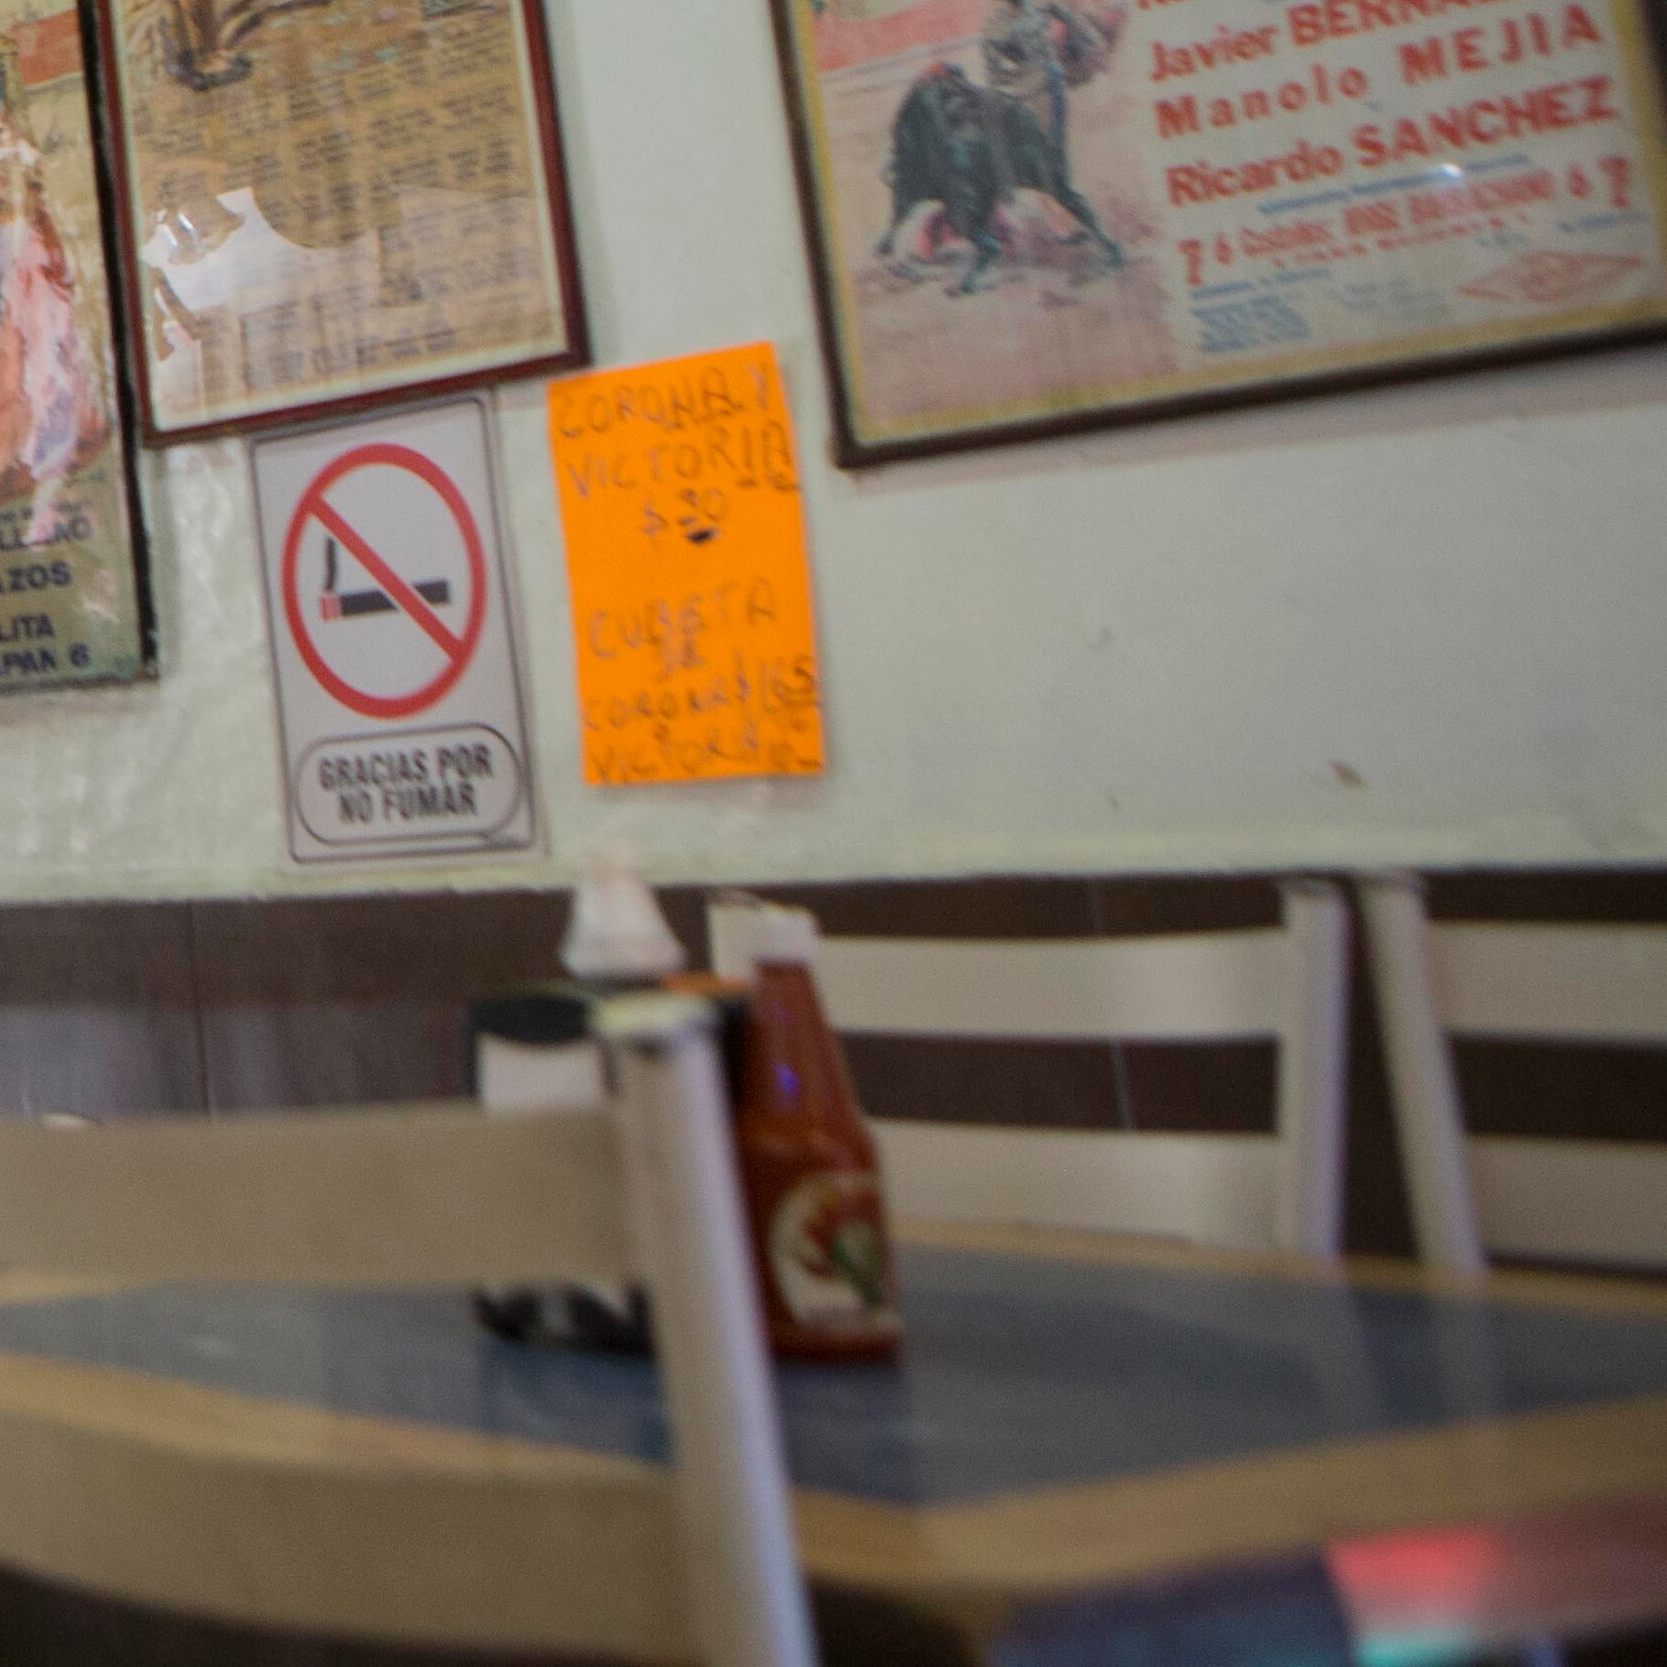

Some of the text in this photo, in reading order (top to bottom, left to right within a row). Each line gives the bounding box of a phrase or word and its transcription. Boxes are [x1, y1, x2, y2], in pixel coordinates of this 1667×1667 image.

[1150, 22, 1279, 83] Javier
[1155, 4, 1604, 140] Manolo MEJIA
[1166, 137, 1344, 207] Ricardo
[1352, 74, 1621, 169] SANCHEZ
[320, 741, 494, 791] GRACIAS POR
[340, 779, 478, 823] NO FUMAR
